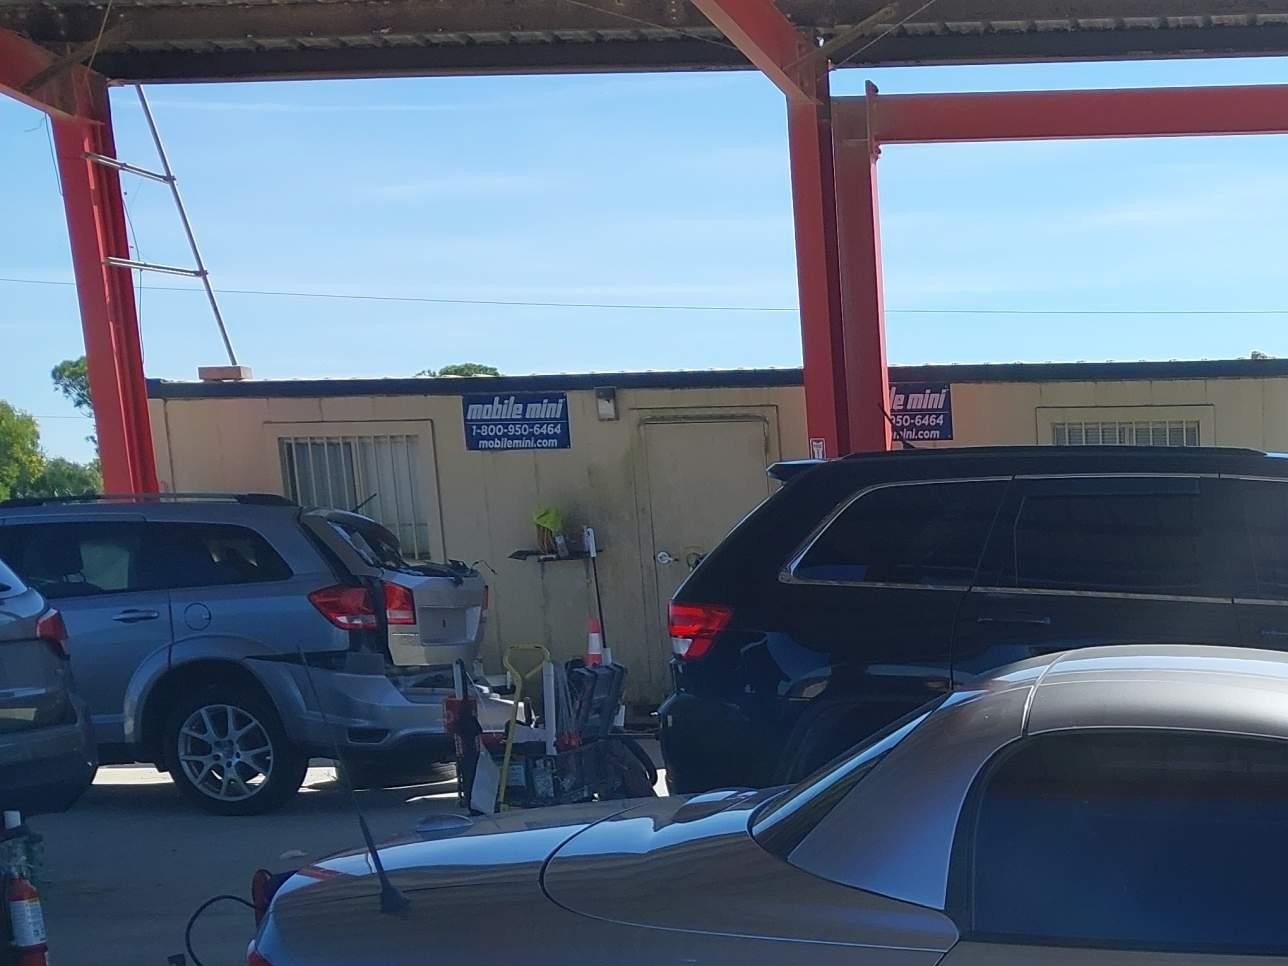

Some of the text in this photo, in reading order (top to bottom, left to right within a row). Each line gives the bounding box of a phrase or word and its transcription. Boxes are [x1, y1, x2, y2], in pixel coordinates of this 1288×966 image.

[466, 395, 564, 420] mobile mini
[907, 388, 946, 410] mini
[471, 423, 561, 436] 1-800-950-6464
[478, 437, 558, 449] mobilemini.com
